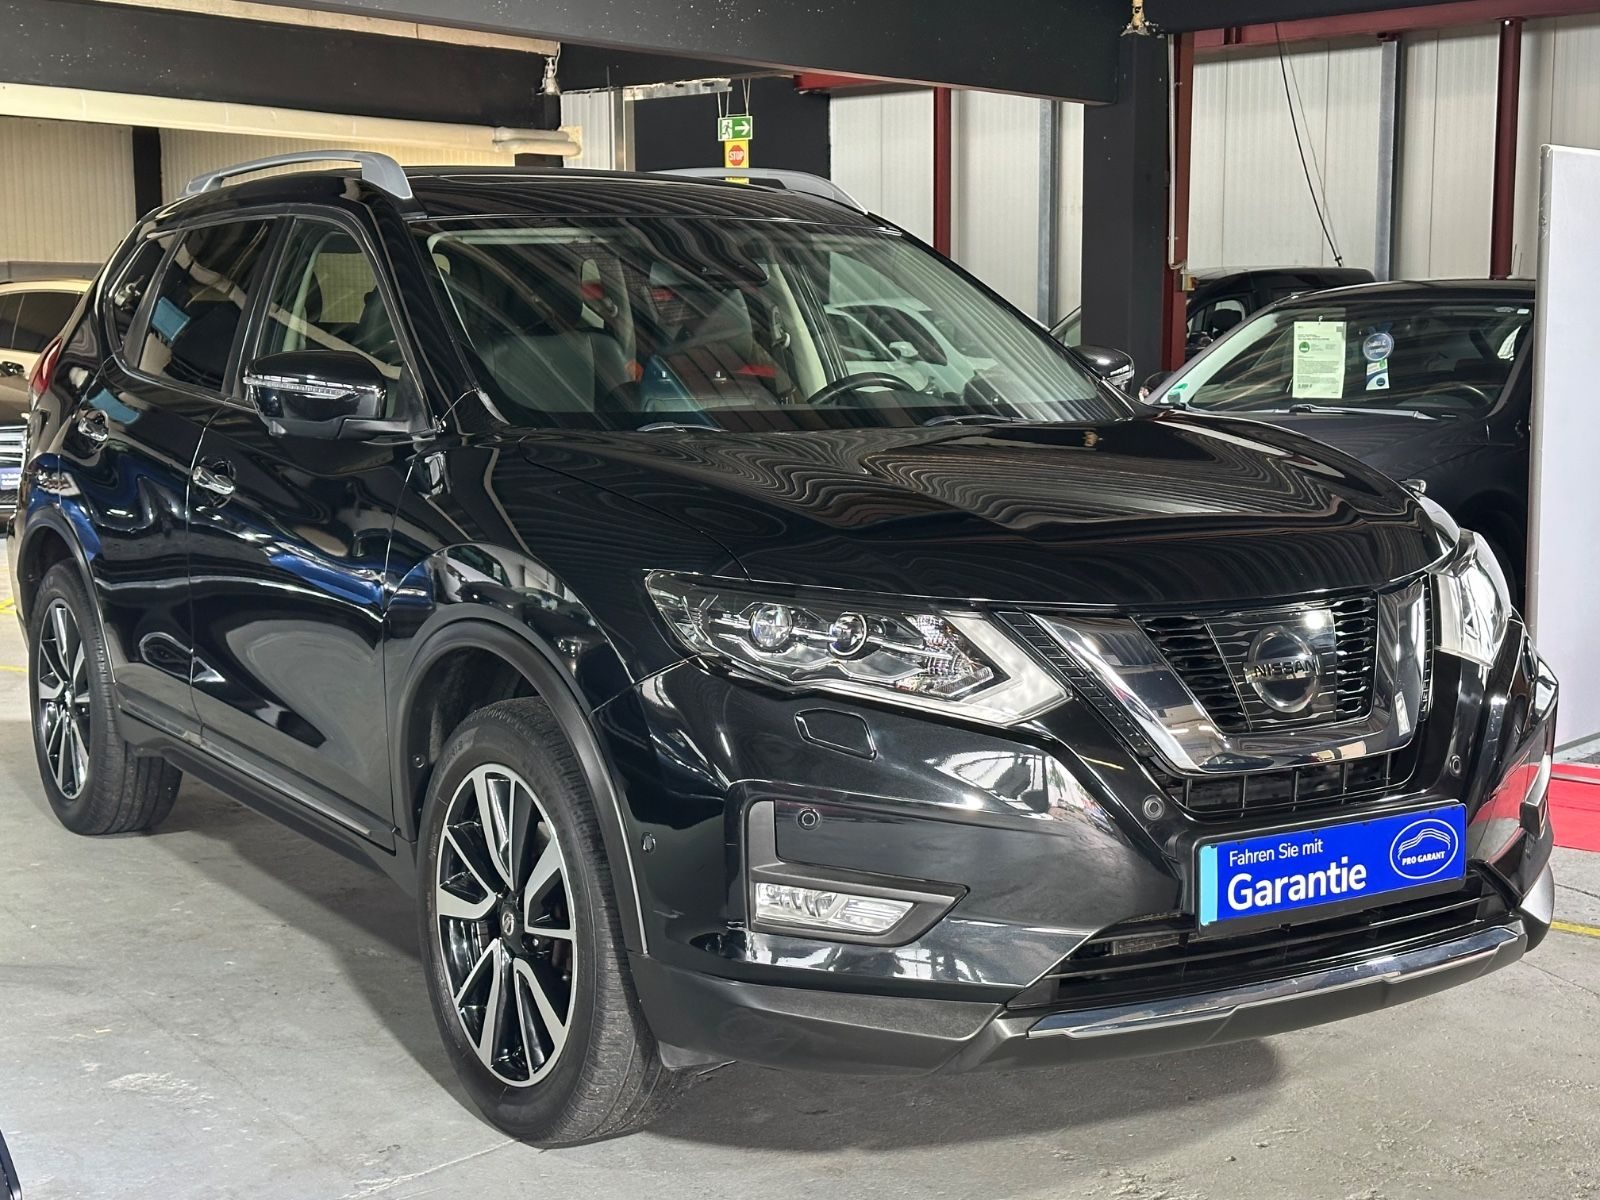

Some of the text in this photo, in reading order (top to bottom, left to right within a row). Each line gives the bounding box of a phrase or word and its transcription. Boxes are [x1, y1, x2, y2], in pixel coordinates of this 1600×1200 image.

[729, 150, 744, 161] STOP
[1254, 659, 1317, 677] NISSAN
[1229, 838, 1324, 867] Fahren Sie mit
[1401, 850, 1446, 866] PRO GARANT
[1227, 856, 1367, 911] Garantie
